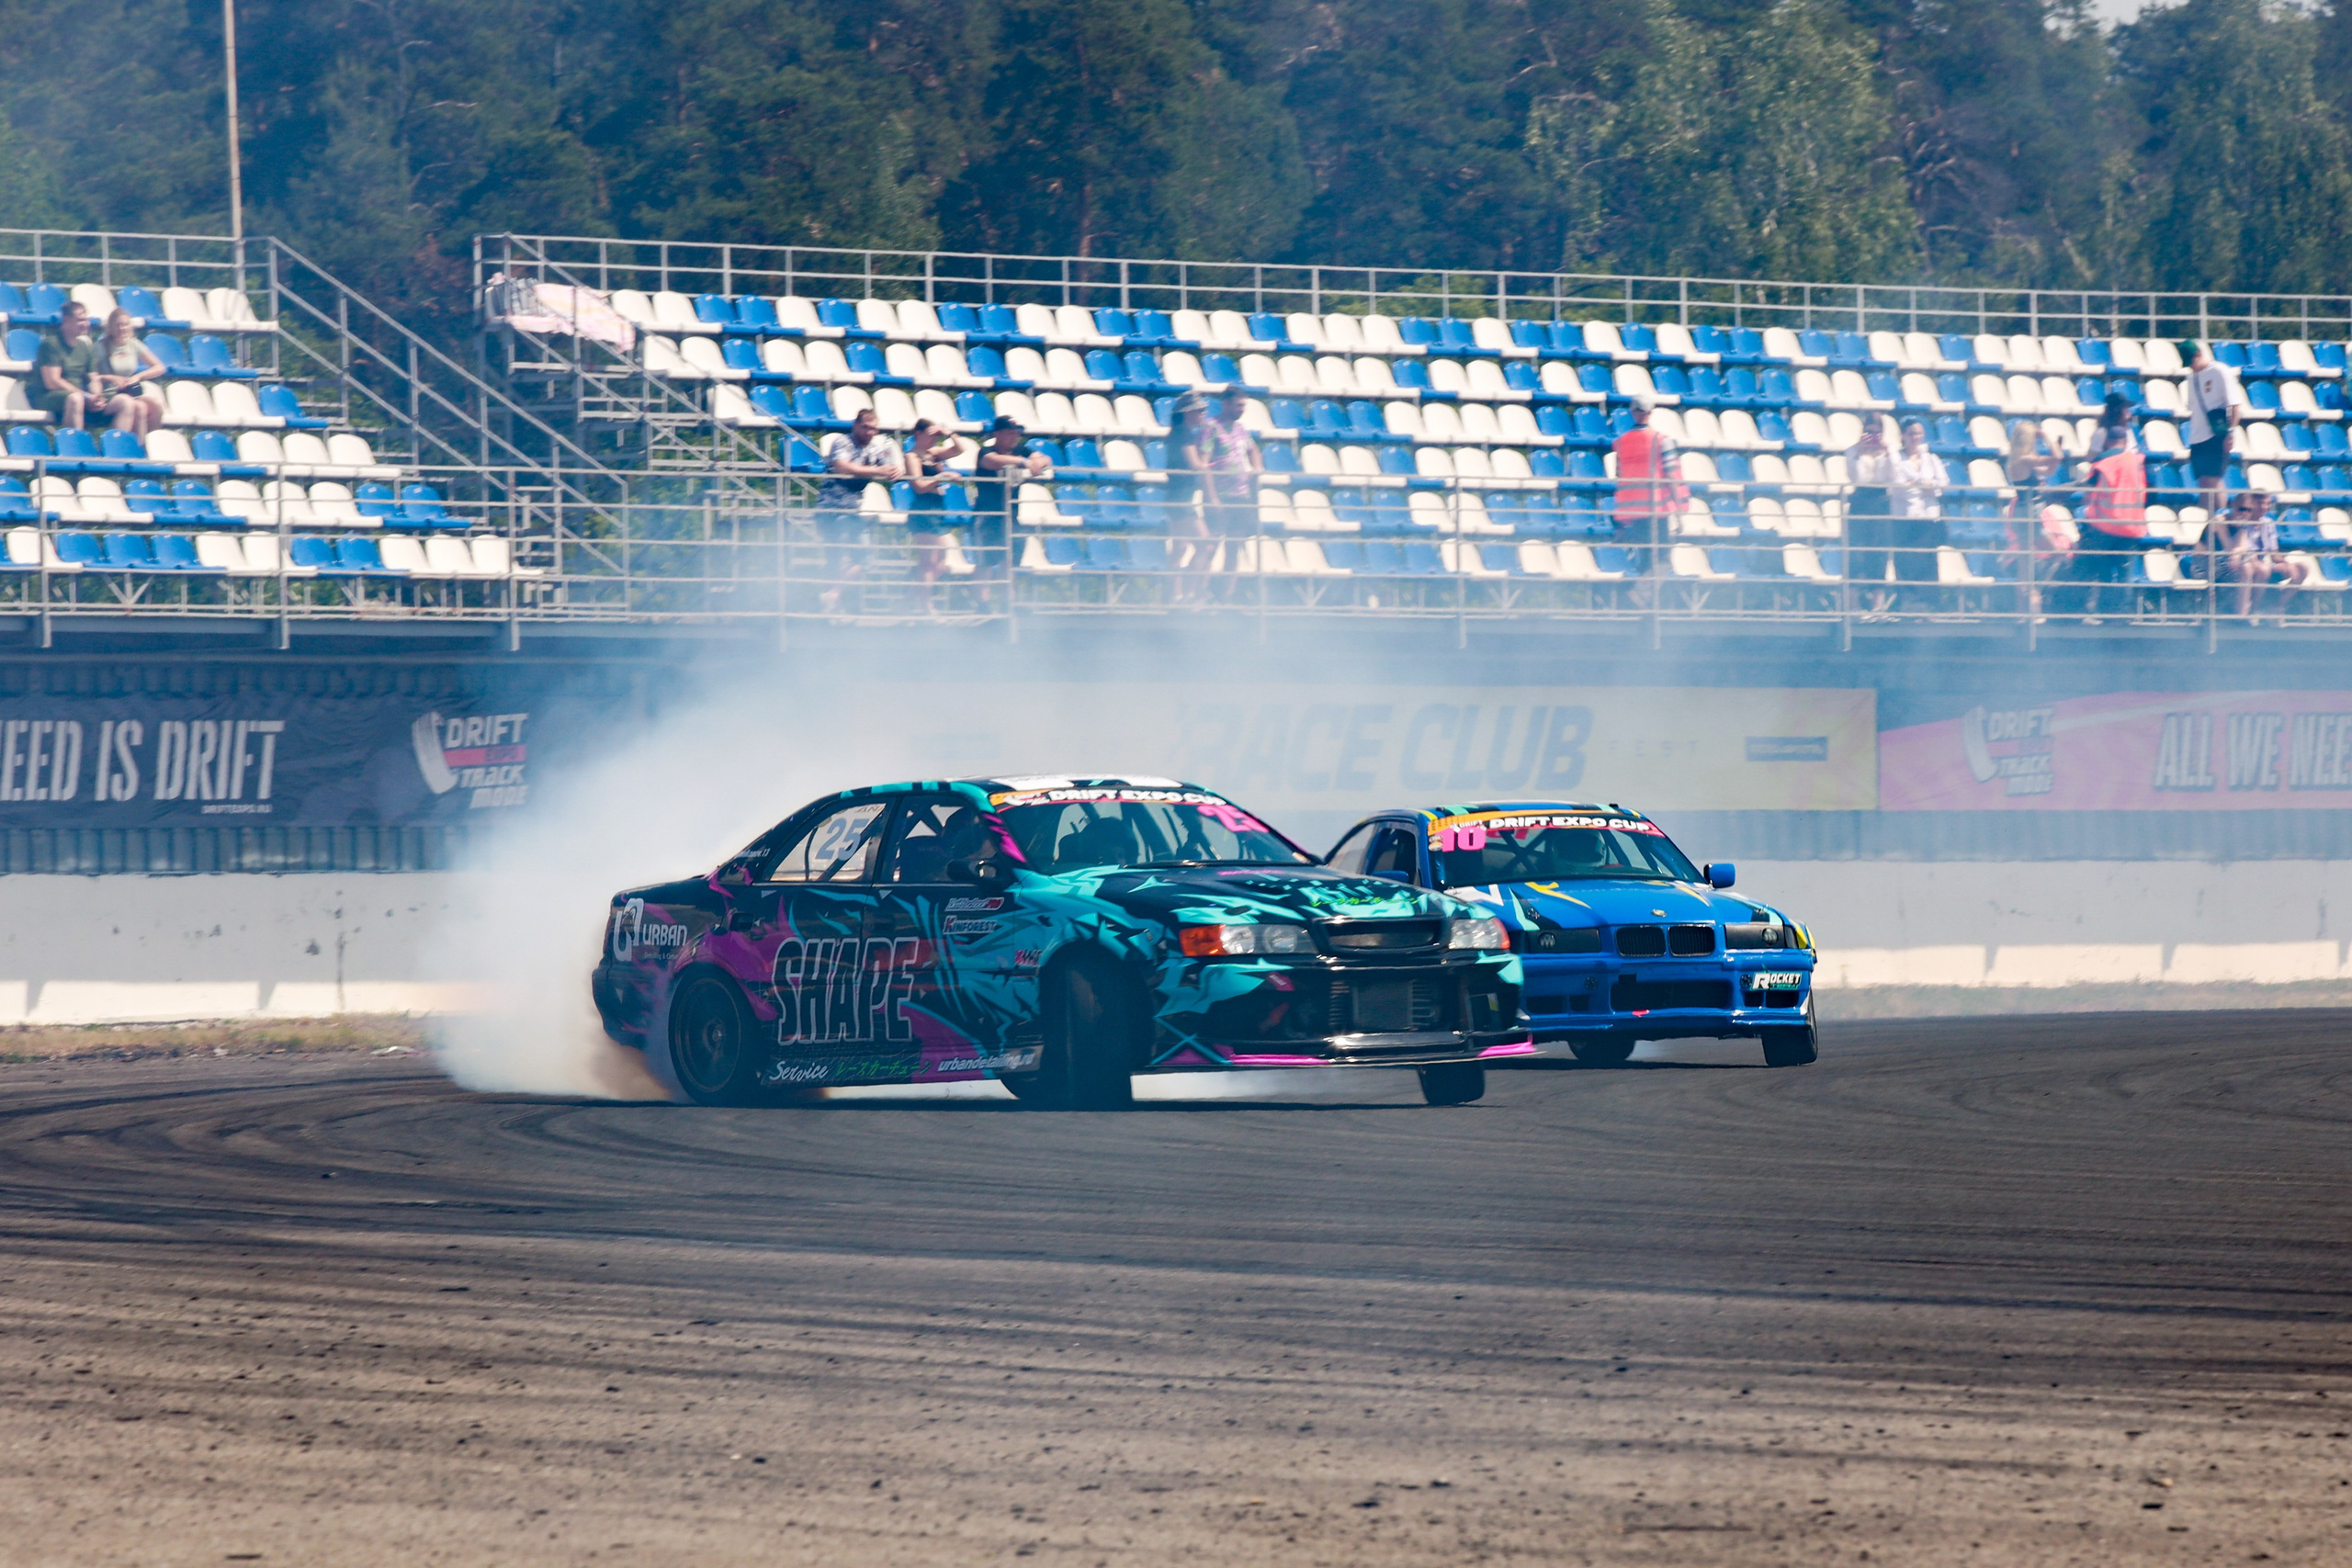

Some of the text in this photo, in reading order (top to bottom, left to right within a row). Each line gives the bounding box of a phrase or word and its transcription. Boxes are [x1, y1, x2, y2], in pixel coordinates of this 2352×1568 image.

[445, 713, 528, 749] DRIFT
[1987, 707, 2054, 741] DRIFT
[0, 720, 285, 802] EED IS DRIFT
[1189, 704, 1595, 793] RACE CLUB
[2152, 713, 2352, 791] ALL WE NEE
[1048, 789, 1118, 802] DRIFT
[1119, 790, 1183, 803] EXPO
[1182, 792, 1227, 807] CUP
[814, 817, 870, 862] 25
[1441, 827, 1487, 852] 10
[1489, 816, 1650, 832] DRIFT EXPO CUP
[643, 923, 687, 946] URBAN
[771, 936, 920, 1046] SHAPE
[1752, 973, 1801, 989] ROCKET
[769, 1060, 829, 1083] Service
